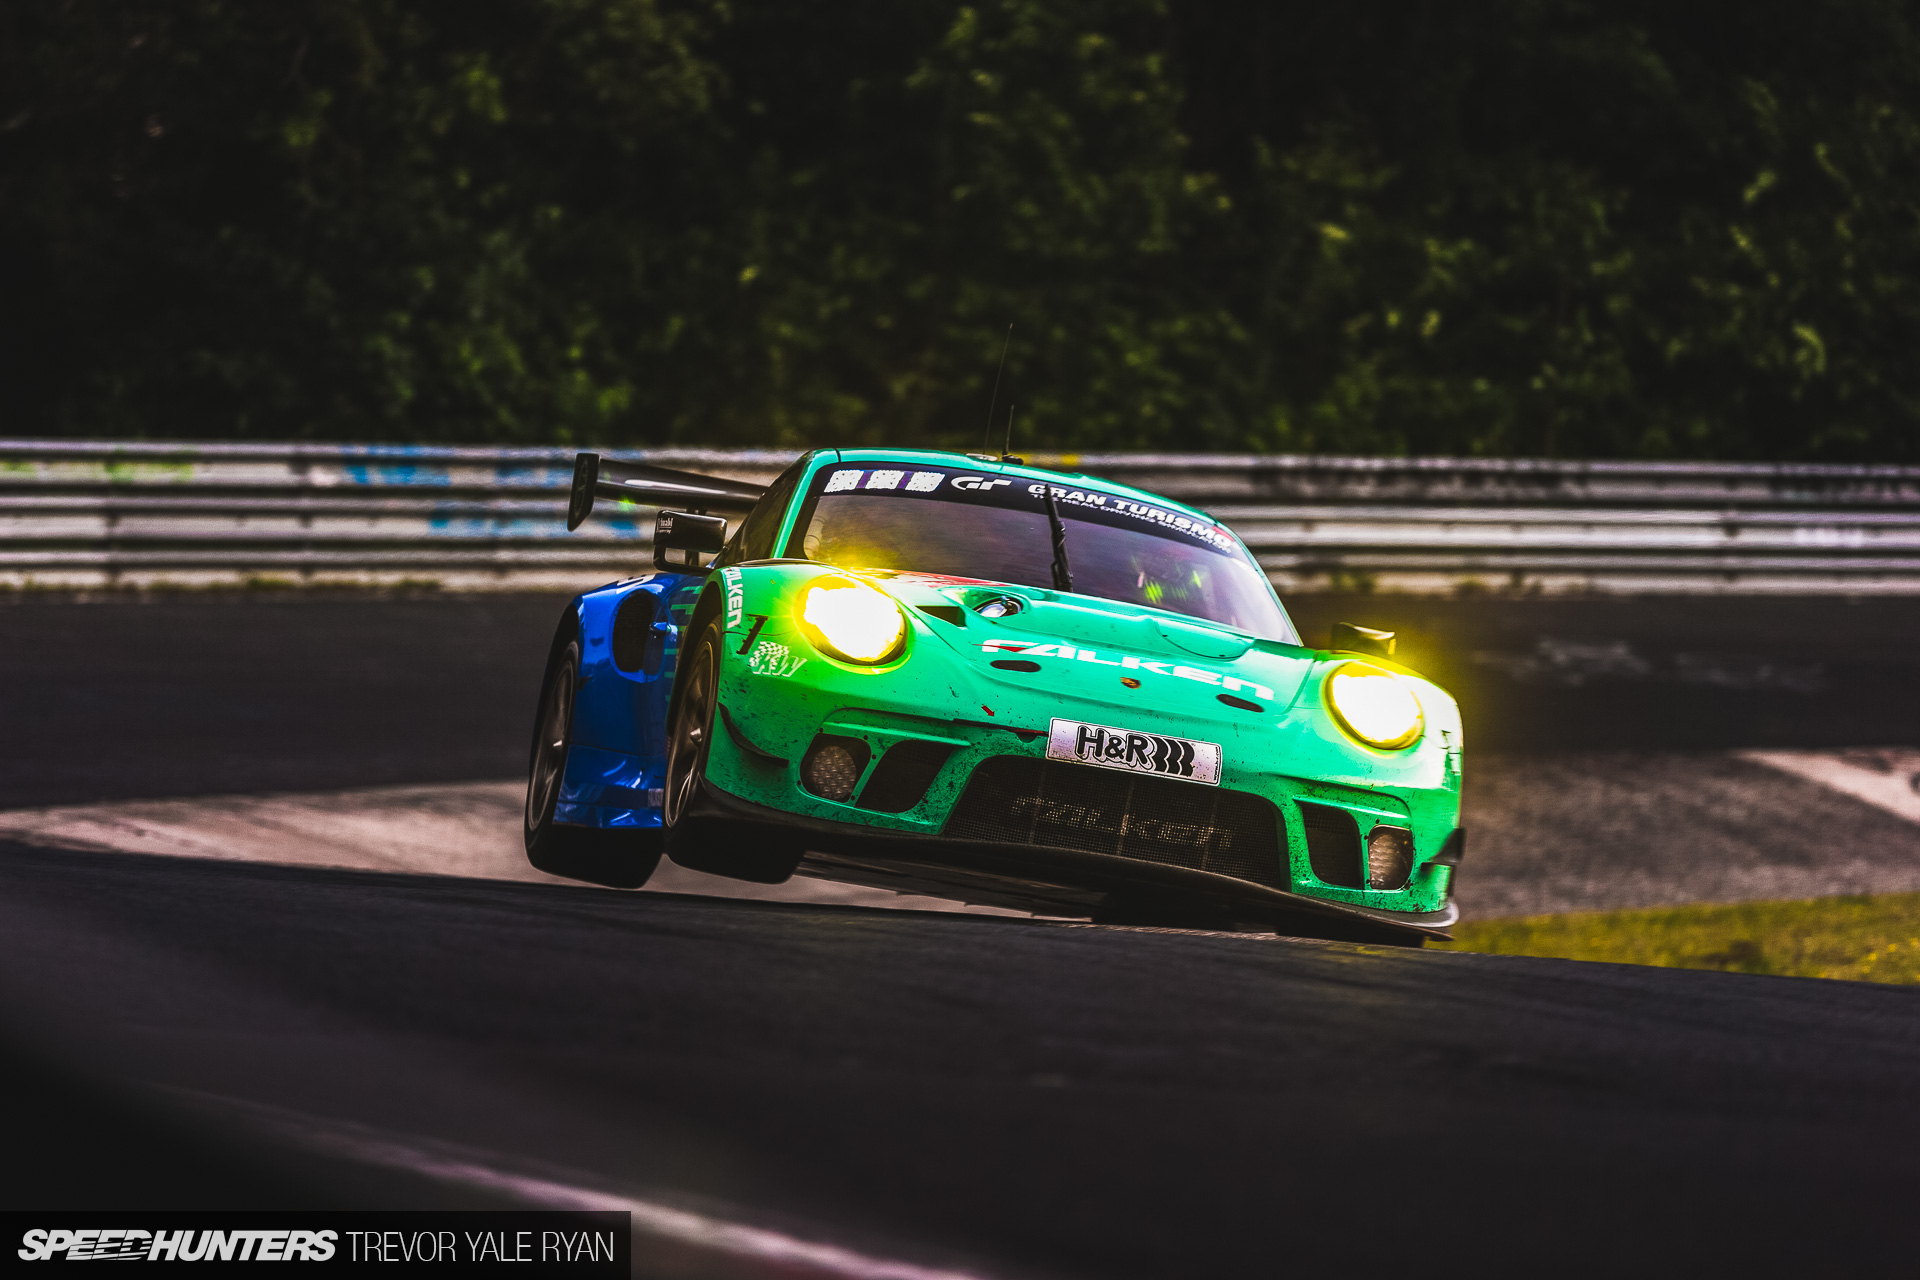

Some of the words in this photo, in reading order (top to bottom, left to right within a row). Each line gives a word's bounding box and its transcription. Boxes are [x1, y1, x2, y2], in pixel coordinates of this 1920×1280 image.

[951, 476, 1012, 491] GT
[1028, 484, 1107, 506] GRAN
[1114, 499, 1233, 547] TURISMO
[721, 567, 743, 629] FALKEN
[981, 638, 1274, 700] FALKEN
[1075, 725, 1153, 769] H&R
